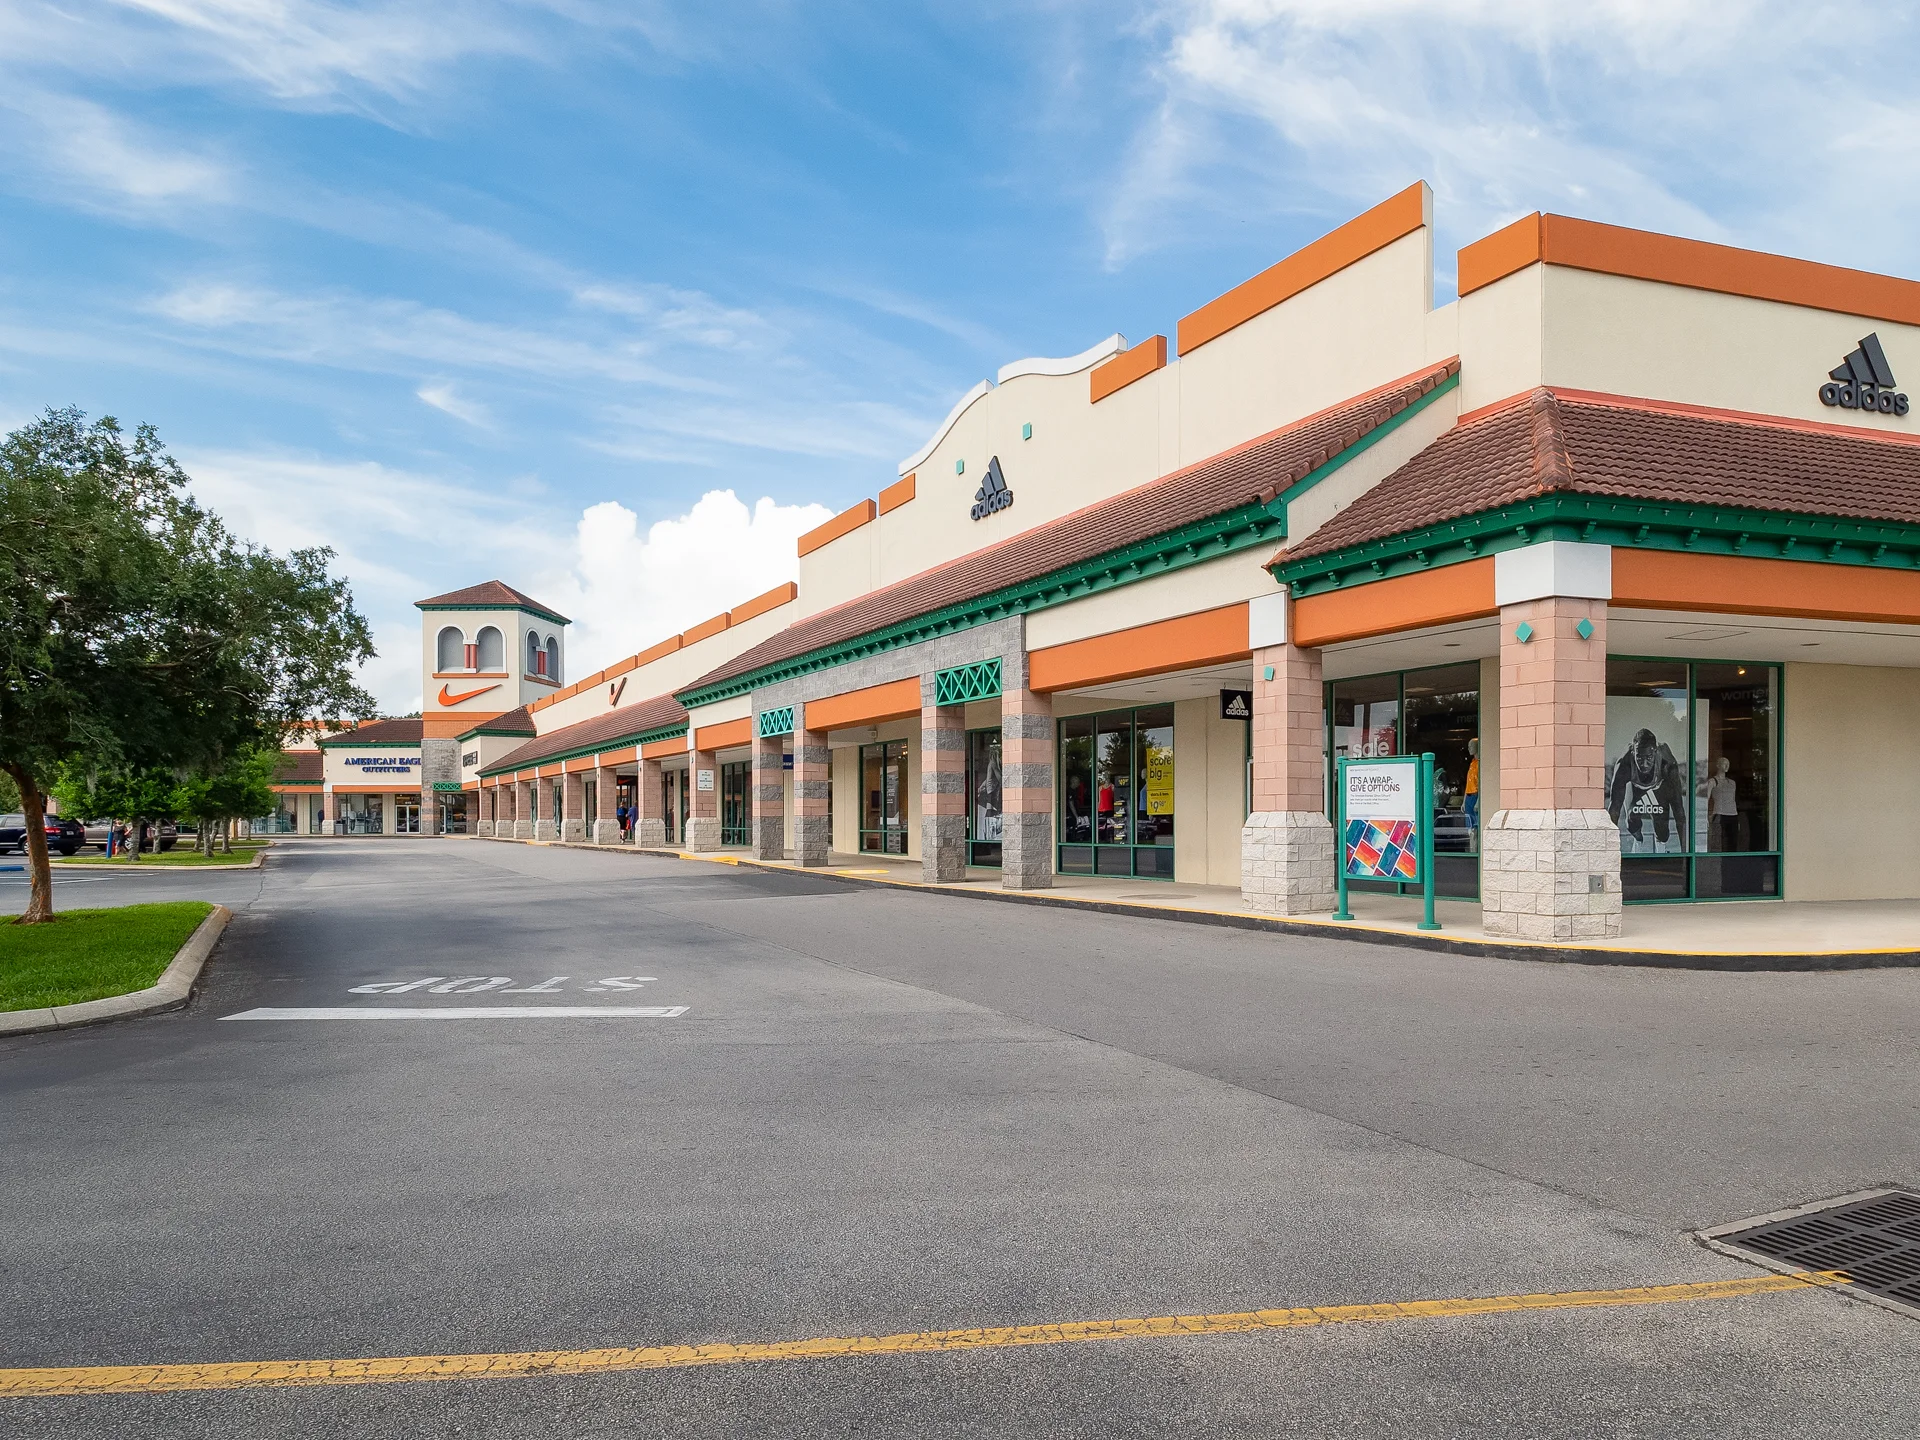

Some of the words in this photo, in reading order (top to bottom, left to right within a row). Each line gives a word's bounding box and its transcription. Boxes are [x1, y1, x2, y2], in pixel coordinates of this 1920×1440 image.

[1819, 380, 1910, 416] adidas
[970, 490, 1014, 521] adidas
[1226, 708, 1249, 716] adidas
[1352, 738, 1390, 757] sale
[344, 757, 397, 765] AMERICAN
[1149, 756, 1172, 766] score
[1149, 768, 1162, 780] big
[1350, 776, 1362, 784] IT'S
[1363, 776, 1369, 784] A
[1369, 775, 1393, 784] WRAP:
[1350, 784, 1366, 792] GIVE
[1367, 783, 1401, 792] OPTIONS
[1632, 804, 1664, 814] adidas
[347, 976, 658, 994] STOP
